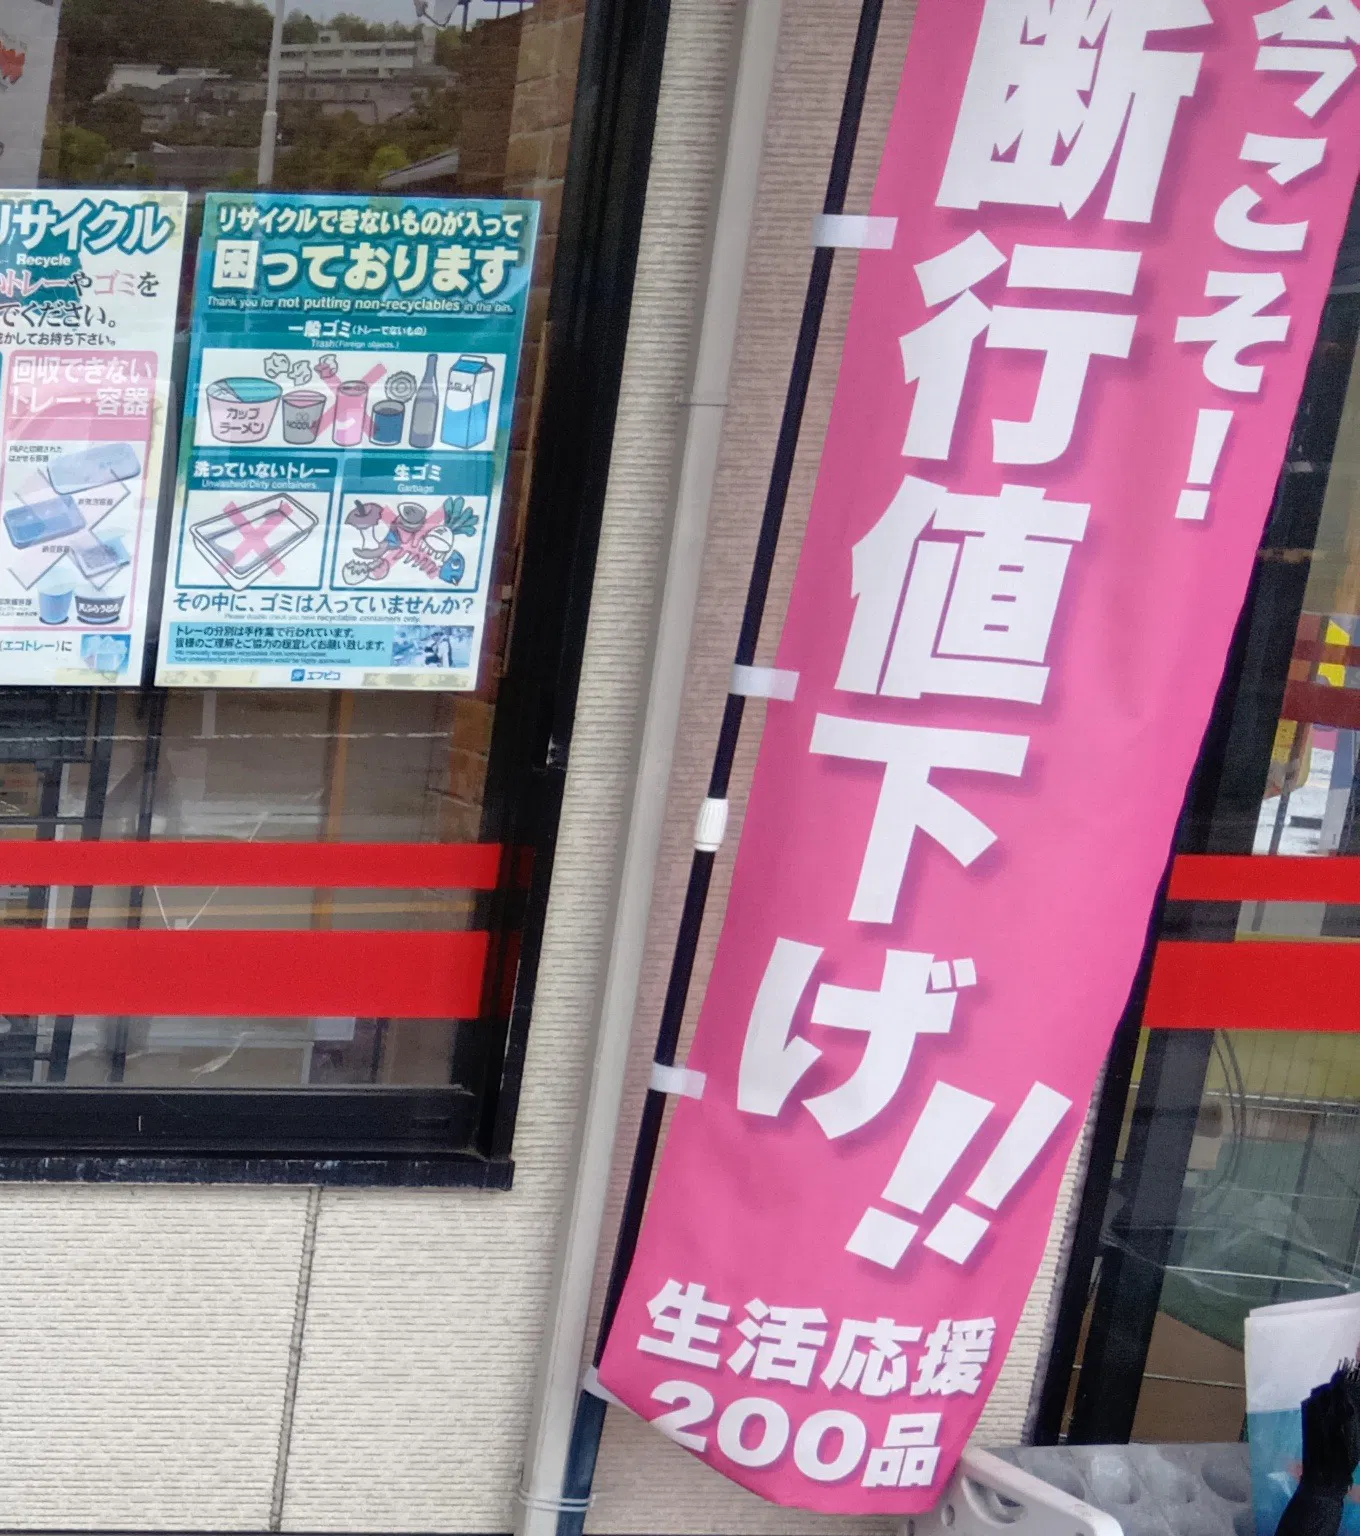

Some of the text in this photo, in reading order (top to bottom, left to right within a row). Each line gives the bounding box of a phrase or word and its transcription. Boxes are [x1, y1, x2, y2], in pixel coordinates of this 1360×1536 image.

[218, 204, 524, 237] リサイクルできないものが入って
[16, 252, 71, 268] Recycle
[211, 238, 519, 295] 困っております
[207, 296, 237, 308] Thank
[240, 298, 258, 309] you
[260, 297, 275, 307] for
[278, 297, 300, 309] not
[303, 297, 352, 311] putting
[355, 298, 461, 313] non-recyclables
[476, 302, 492, 312] the
[12, 356, 153, 385] 回収できない
[11, 387, 152, 417] トレー・容器
[225, 407, 261, 421] カップ
[218, 421, 265, 436] ラーメン
[193, 460, 331, 480] 洗っていないトレー
[393, 463, 443, 483] 生ゴミ
[397, 483, 435, 495] Garbage
[172, 591, 475, 615] その中に、ゴミは入っていませんか?
[175, 625, 355, 639] トレーの分別は手作業で行われています。
[637, 1278, 996, 1397] 生活応援
[649, 1380, 944, 1488] 200品
